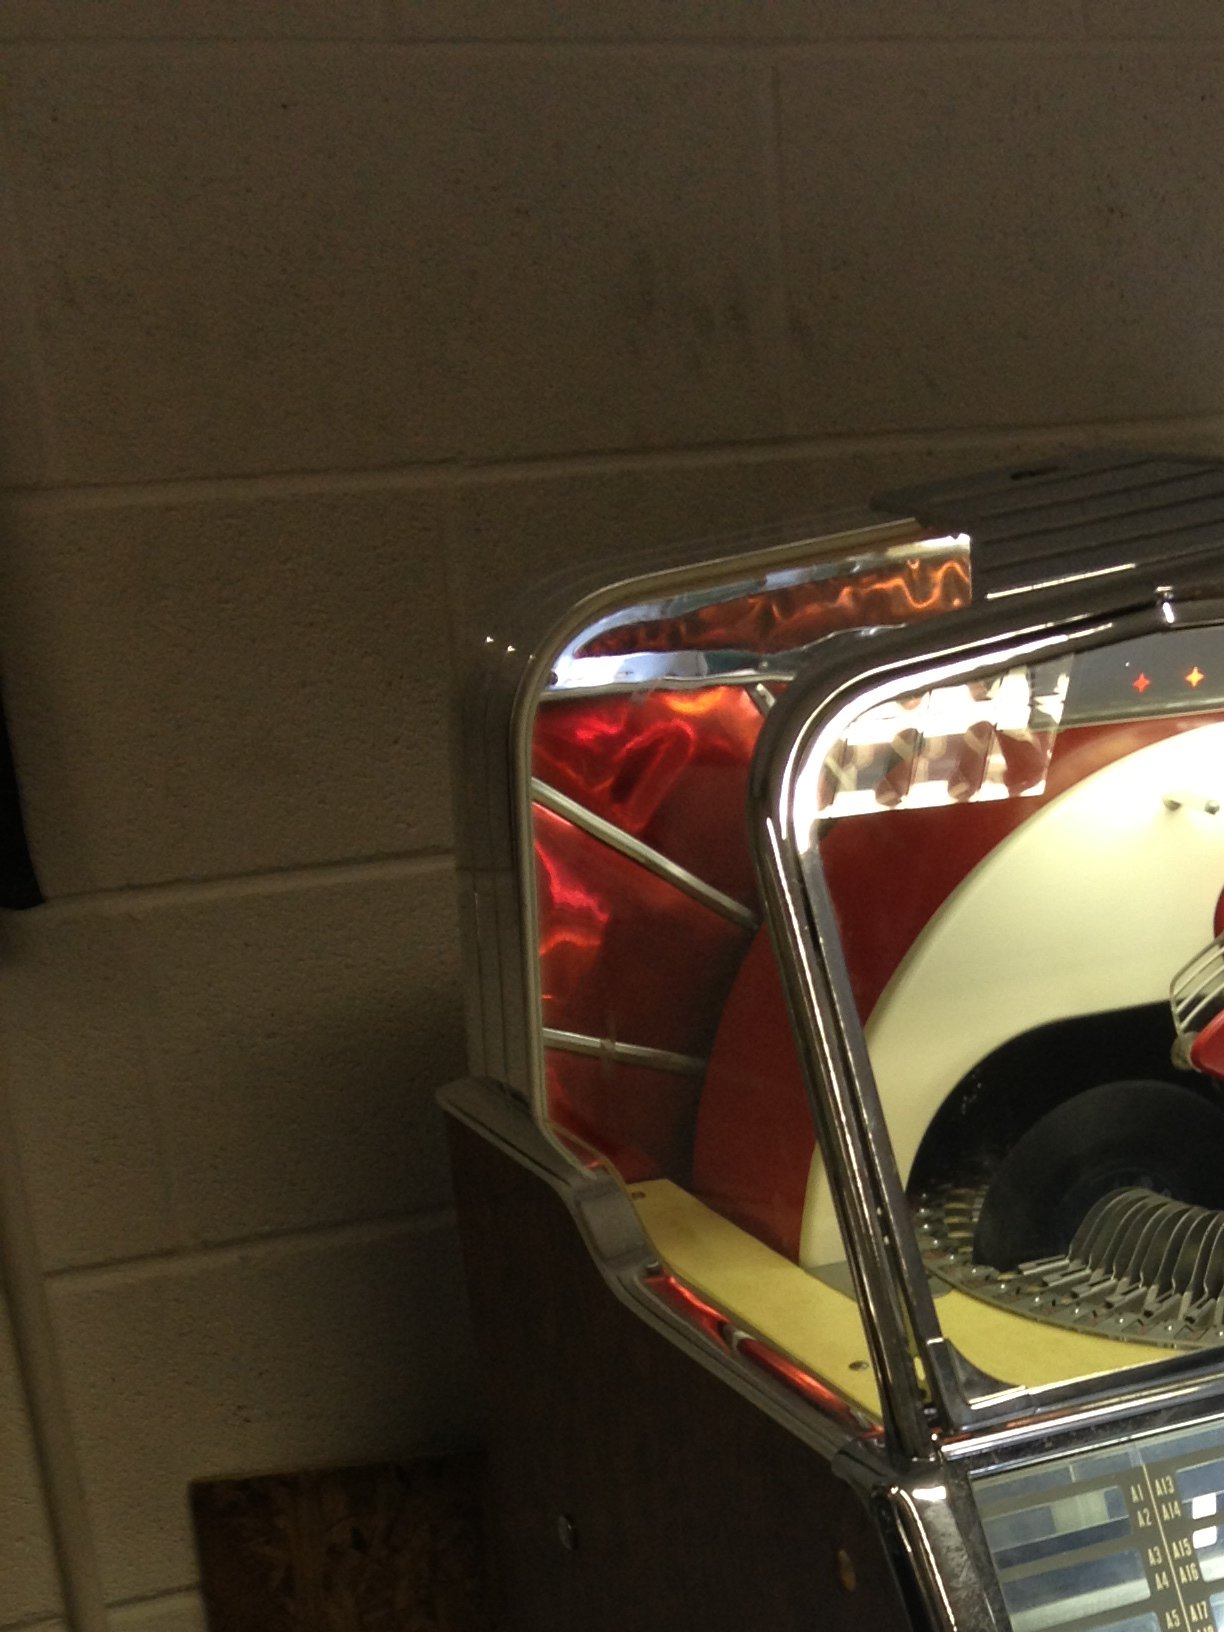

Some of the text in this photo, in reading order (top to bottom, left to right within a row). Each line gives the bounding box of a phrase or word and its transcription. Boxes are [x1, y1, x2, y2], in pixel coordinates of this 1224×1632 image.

[1131, 1484, 1143, 1503] A1
[1155, 1475, 1175, 1496] A13
[1137, 1508, 1152, 1528] A2
[1162, 1501, 1181, 1521] A14
[1148, 1546, 1162, 1566] A3
[1172, 1538, 1192, 1560] A15
[1155, 1571, 1169, 1590] A4
[1179, 1563, 1199, 1584] A16
[1166, 1609, 1180, 1629] A5
[1190, 1601, 1209, 1622] A17
